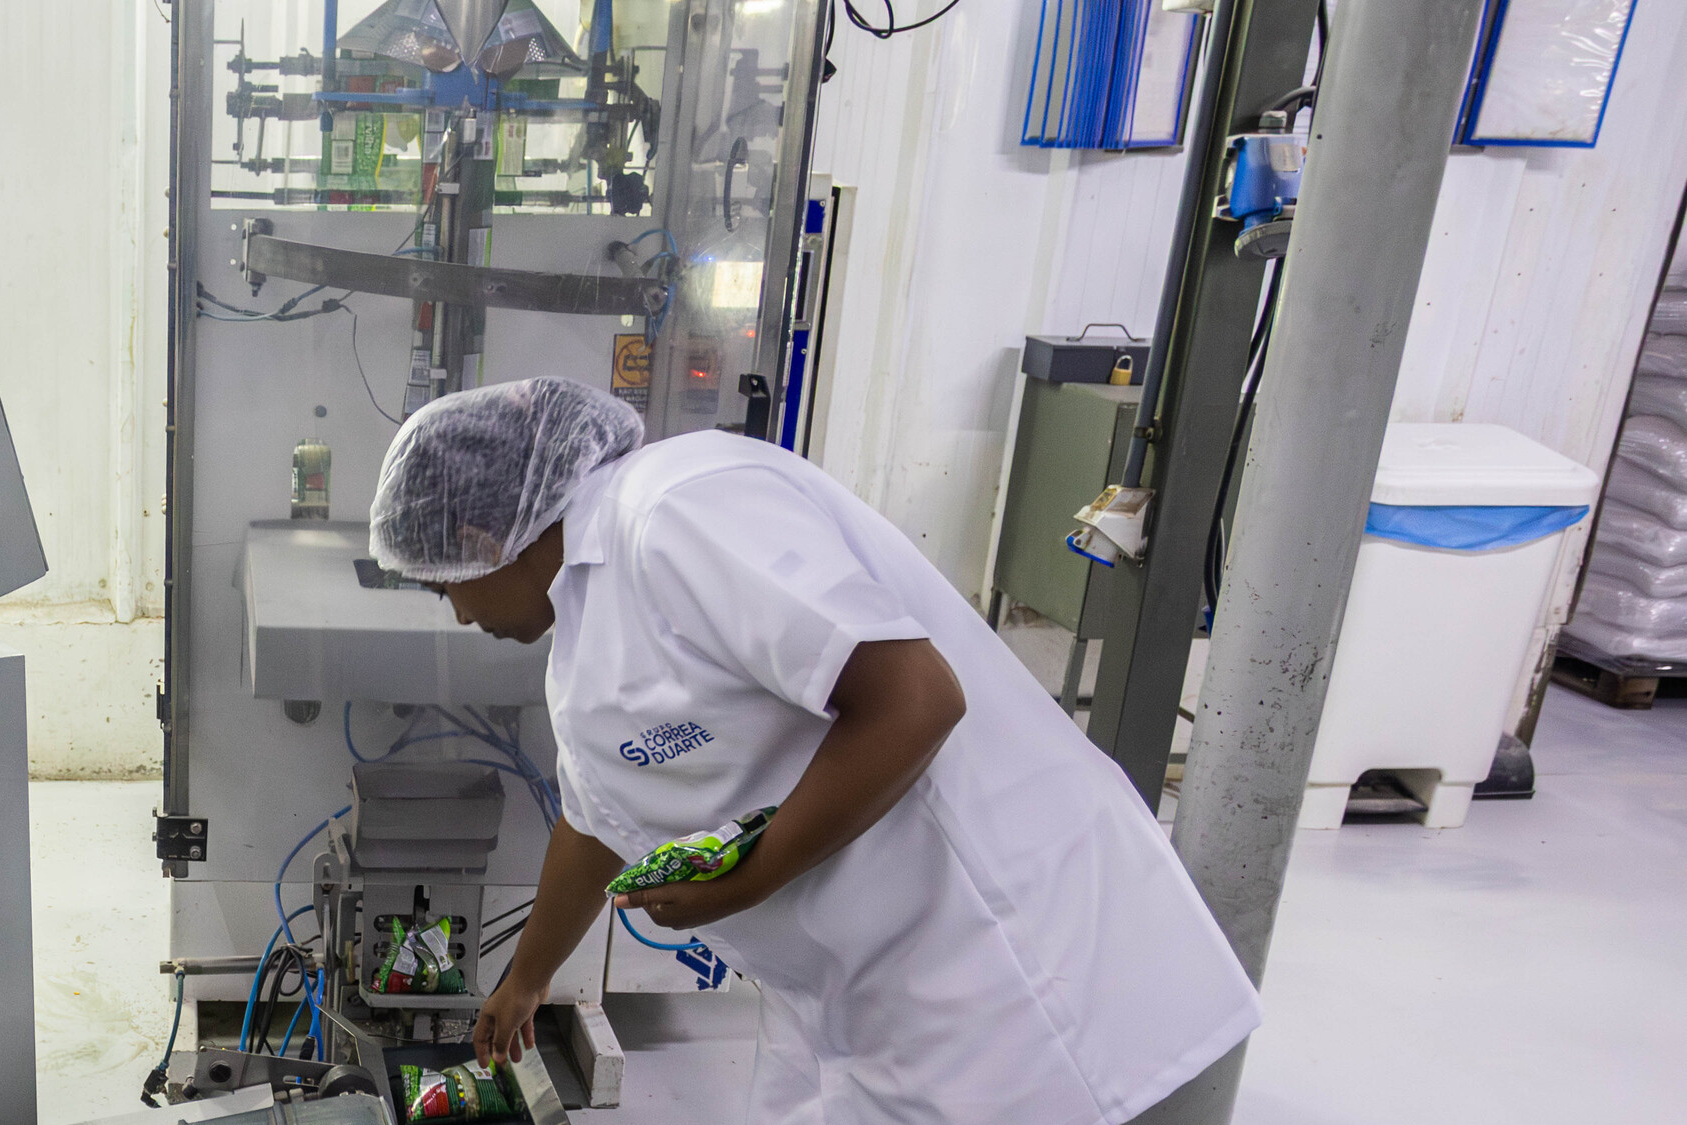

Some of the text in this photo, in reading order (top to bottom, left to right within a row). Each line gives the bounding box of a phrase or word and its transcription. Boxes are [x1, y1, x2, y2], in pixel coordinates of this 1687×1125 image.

[644, 721, 702, 751] CORREA
[650, 729, 715, 764] DUARTE
[635, 857, 683, 887] ervilha
